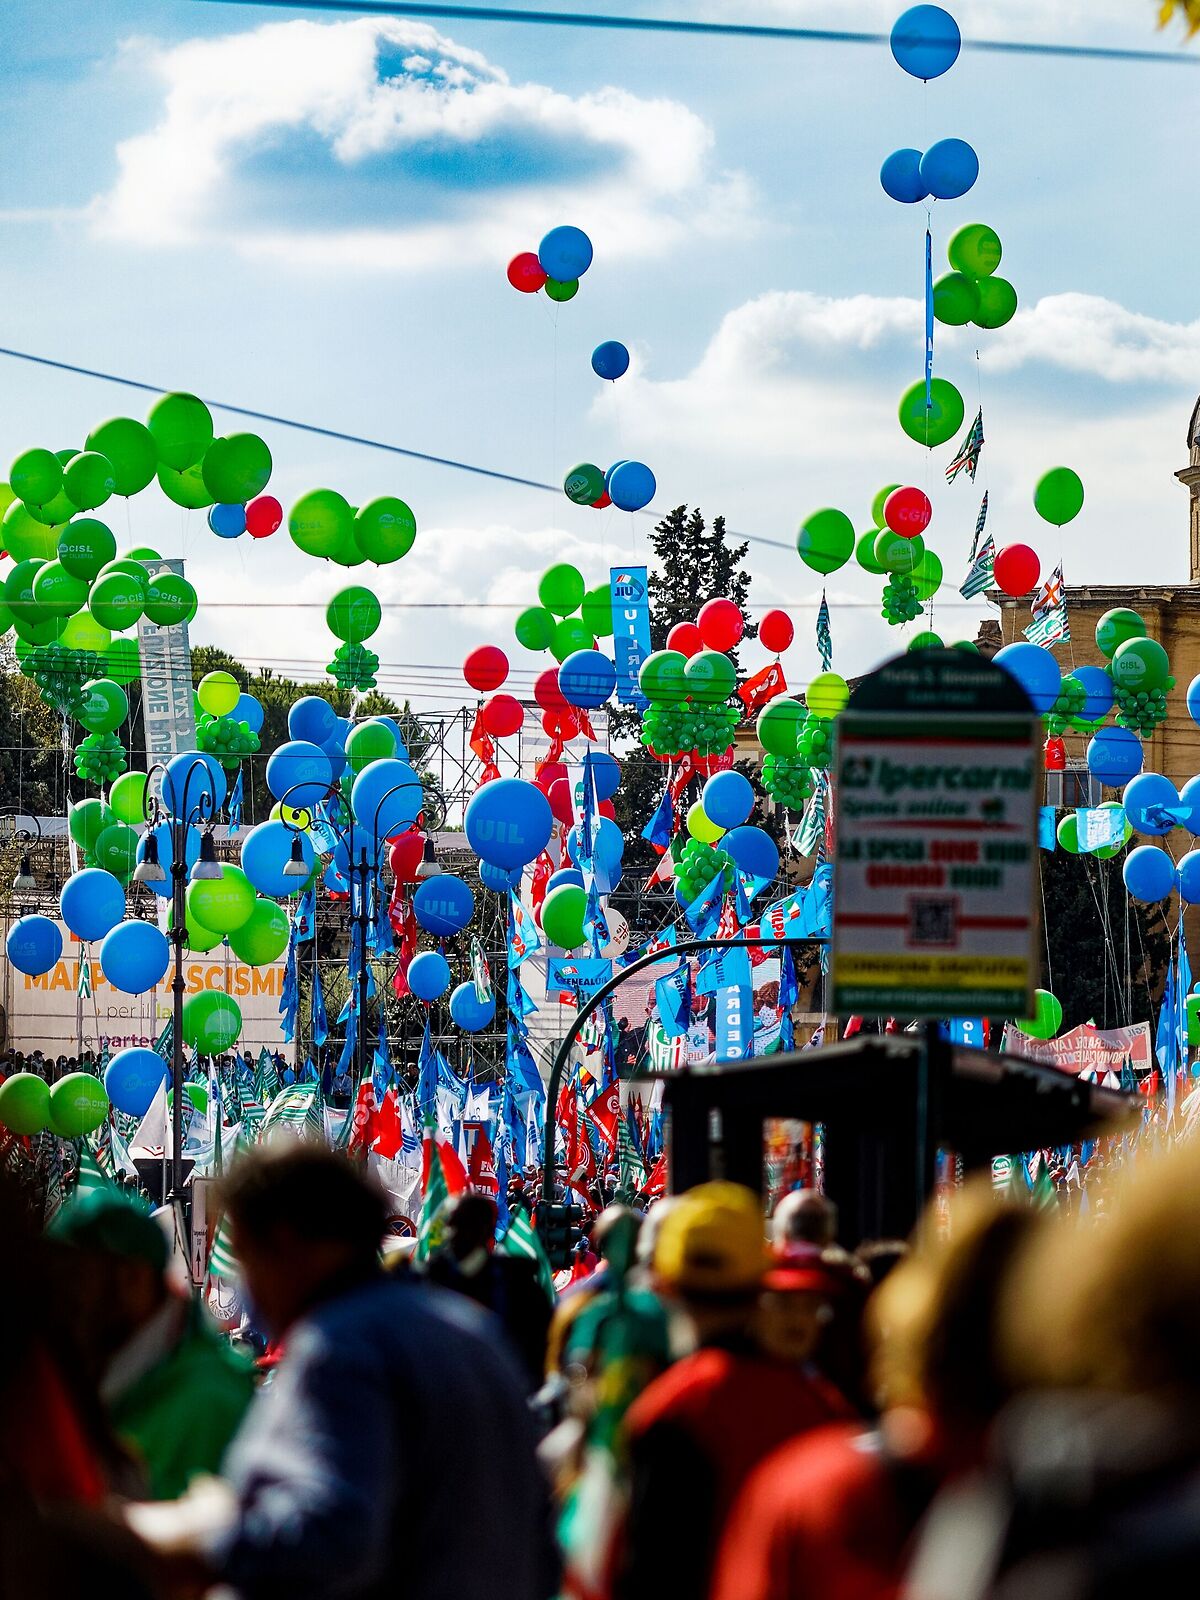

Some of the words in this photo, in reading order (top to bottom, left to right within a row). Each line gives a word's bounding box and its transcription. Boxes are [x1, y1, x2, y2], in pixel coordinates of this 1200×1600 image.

[567, 478, 586, 493] CISL
[68, 544, 94, 553] CISL
[128, 592, 144, 602] CIS
[160, 591, 184, 606] CISL
[690, 664, 709, 674] CISL
[1119, 660, 1141, 670] CISL
[475, 818, 525, 844] UIL
[424, 899, 460, 916] UIL
[151, 963, 285, 997] ASCISMI
[107, 1004, 136, 1022] per
[141, 1003, 150, 1019] il
